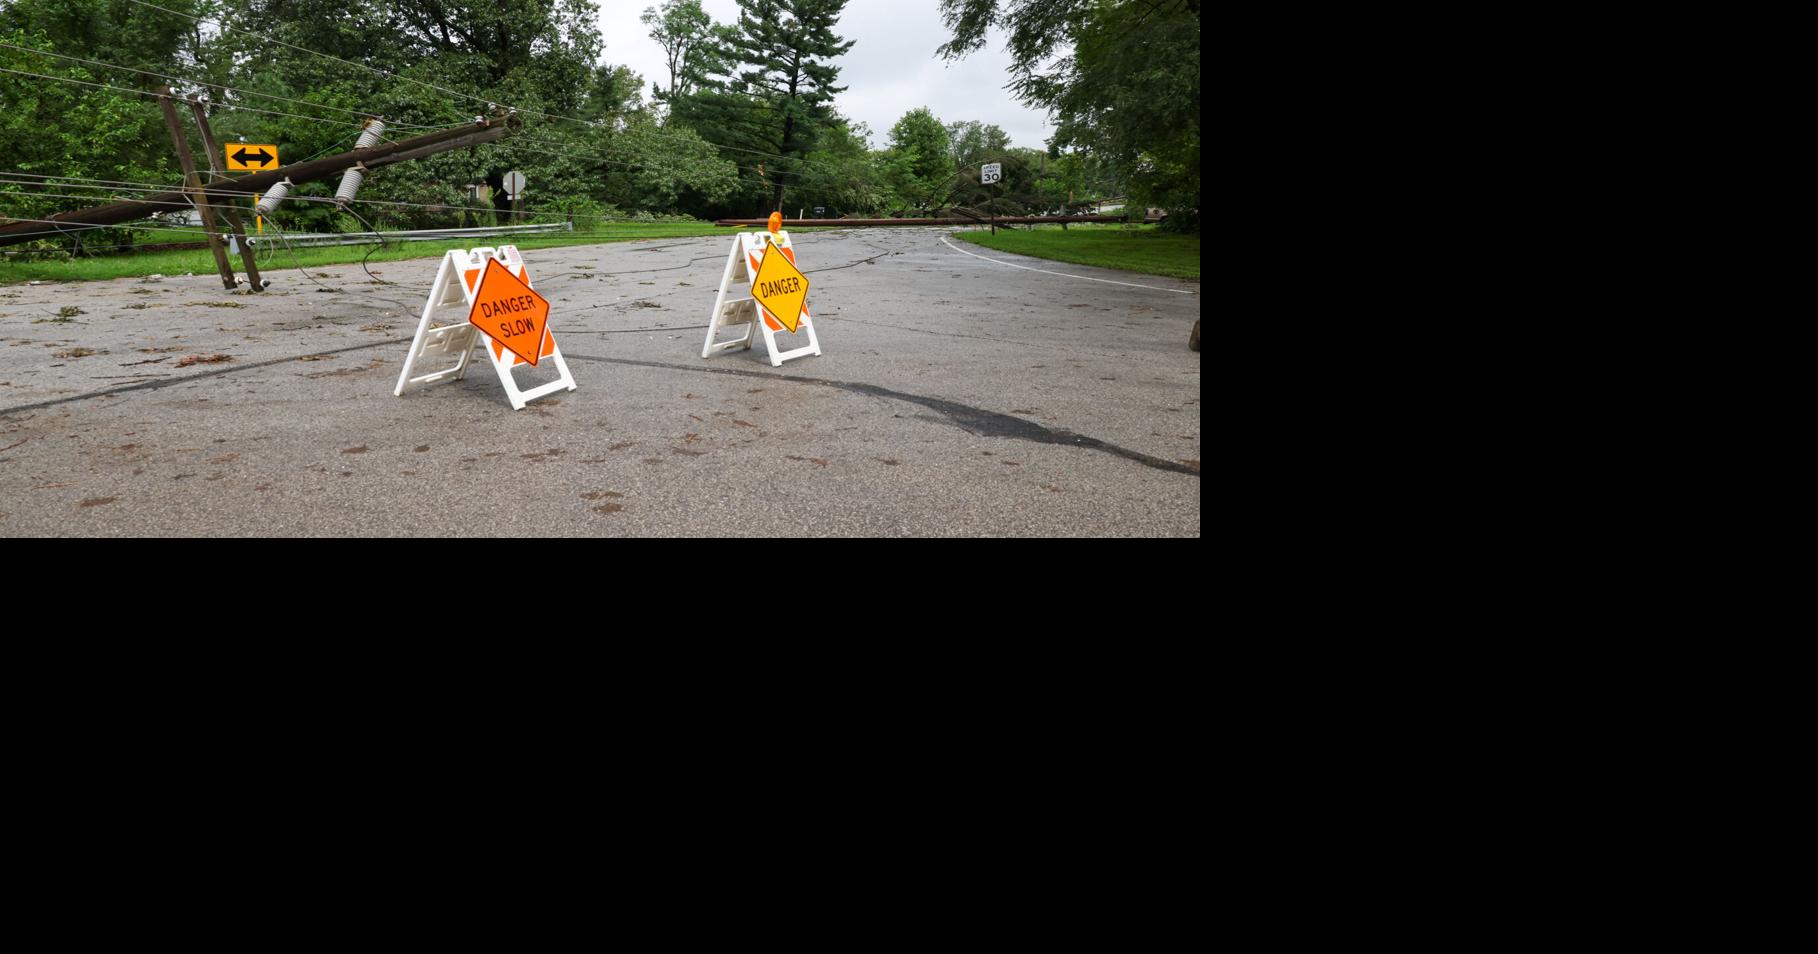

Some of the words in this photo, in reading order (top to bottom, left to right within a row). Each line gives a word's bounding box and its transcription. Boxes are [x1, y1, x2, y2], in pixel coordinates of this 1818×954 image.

[984, 173, 999, 182] 30
[760, 277, 801, 298] DANGER
[481, 295, 536, 318] DANGER
[500, 316, 535, 338] SLOW
